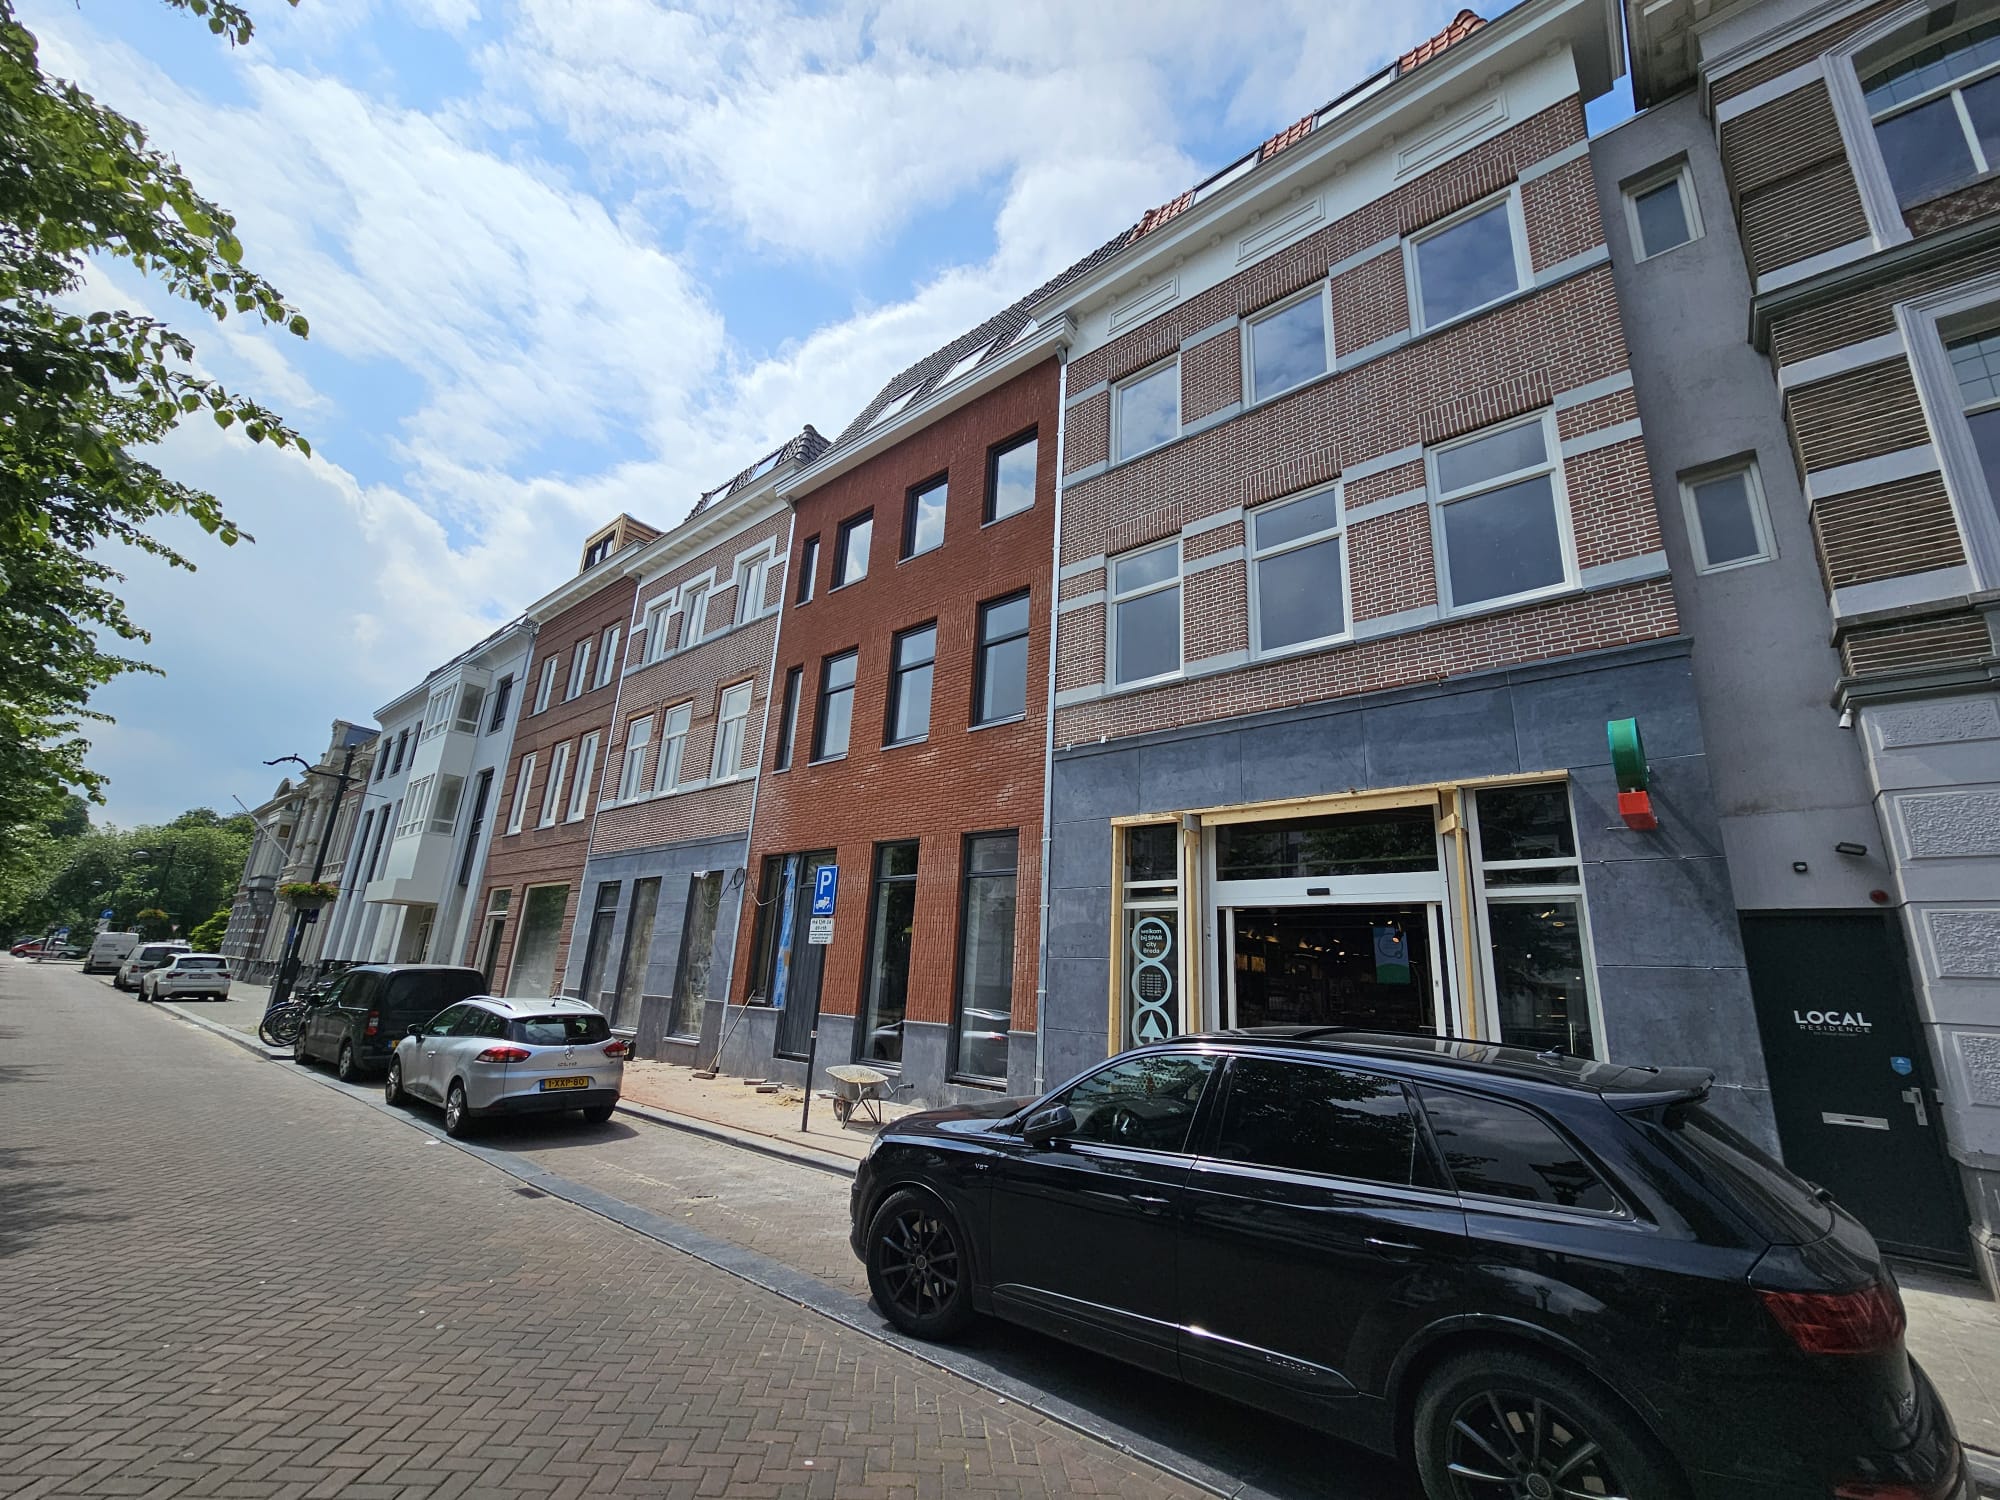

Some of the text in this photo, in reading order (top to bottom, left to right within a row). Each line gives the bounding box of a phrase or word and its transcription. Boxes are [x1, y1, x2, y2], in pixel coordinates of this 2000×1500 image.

[820, 871, 832, 895] P
[1793, 1010, 1872, 1027] LOCAL
[1800, 1025, 1871, 1033] RESIDENCE
[548, 1078, 585, 1088] 1-XXP-80
